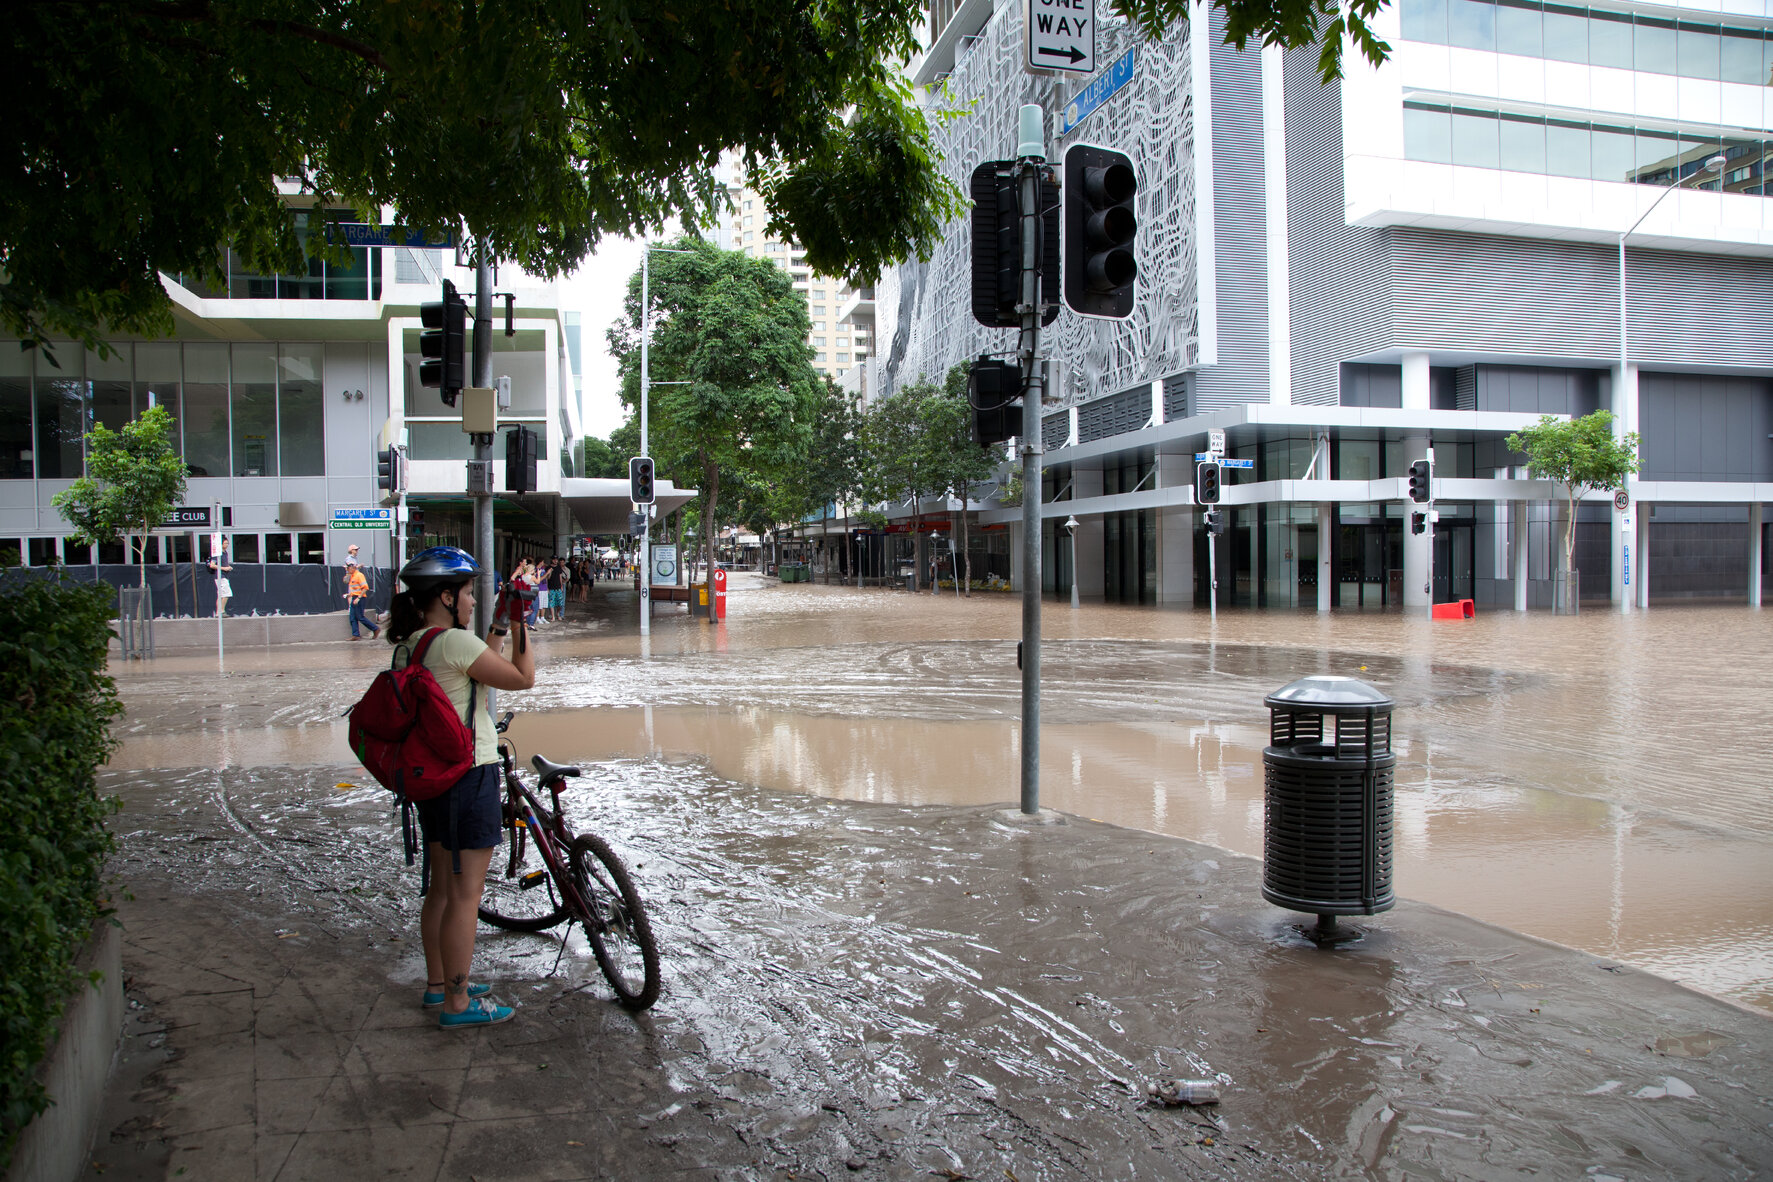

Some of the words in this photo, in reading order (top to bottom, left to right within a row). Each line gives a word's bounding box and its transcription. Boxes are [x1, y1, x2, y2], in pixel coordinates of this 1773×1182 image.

[1037, 13, 1088, 38] WAY
[1083, 65, 1115, 108] ALBERT
[1119, 53, 1129, 77] ST
[328, 225, 390, 239] MARGARE
[1617, 496, 1627, 505] 40
[182, 512, 206, 521] CLUB
